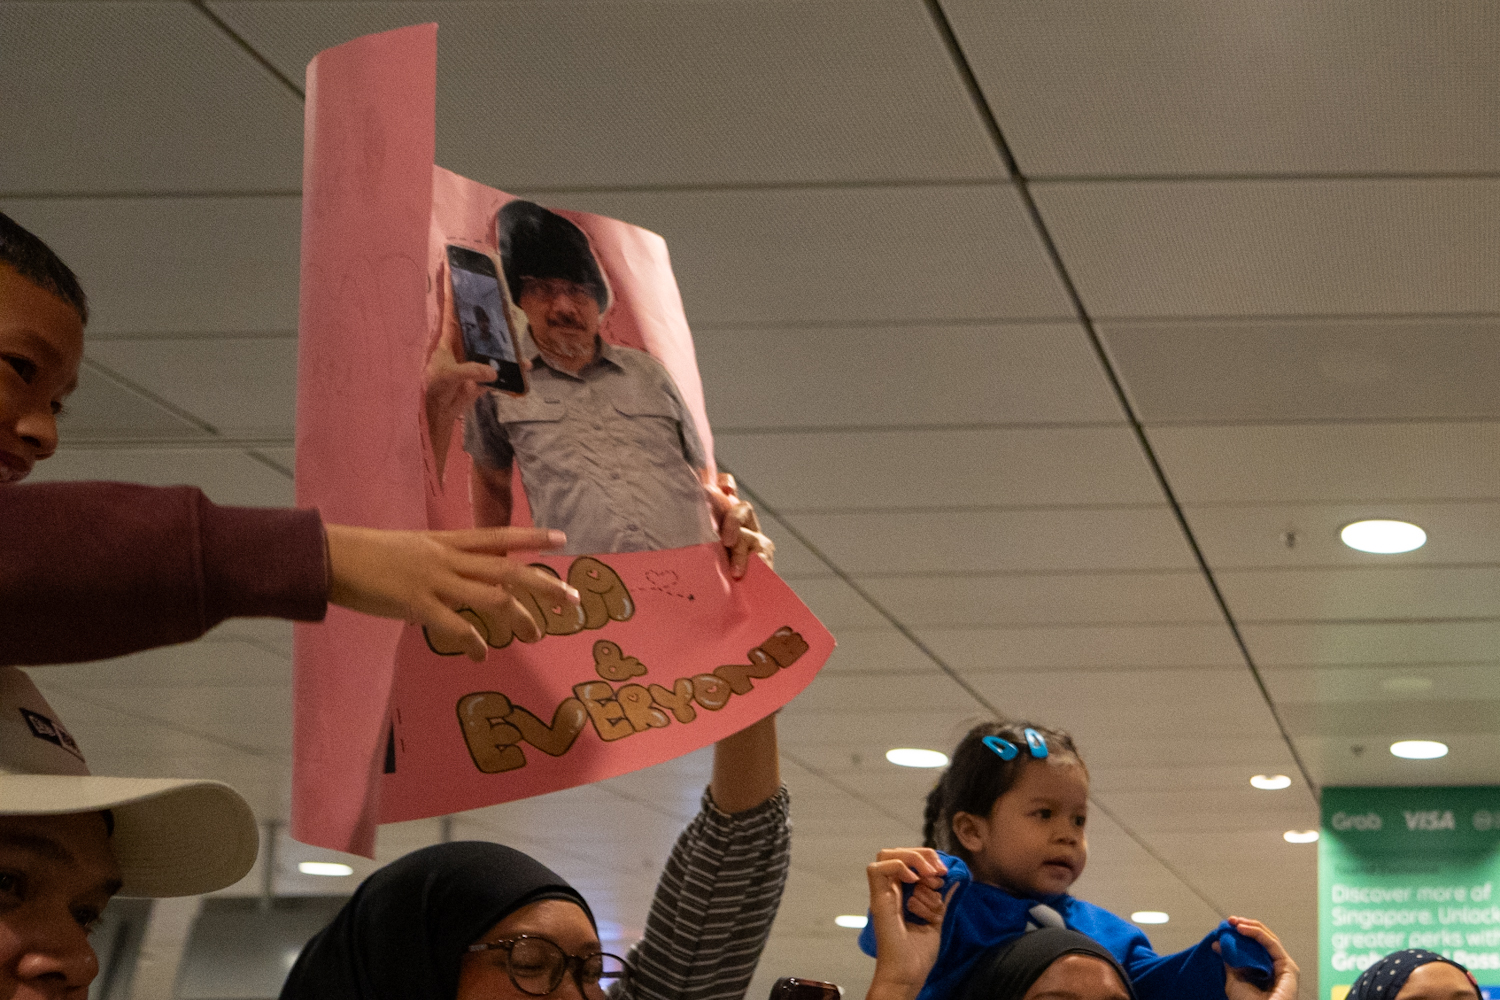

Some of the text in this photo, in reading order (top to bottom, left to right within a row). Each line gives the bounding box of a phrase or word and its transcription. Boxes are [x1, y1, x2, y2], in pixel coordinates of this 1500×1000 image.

[592, 639, 648, 682] &
[456, 625, 810, 774] EVERYONE
[1404, 811, 1455, 831] VISA
[1331, 882, 1493, 904] Discover more of
[1331, 930, 1406, 950] greater
[1408, 929, 1464, 949] perks
